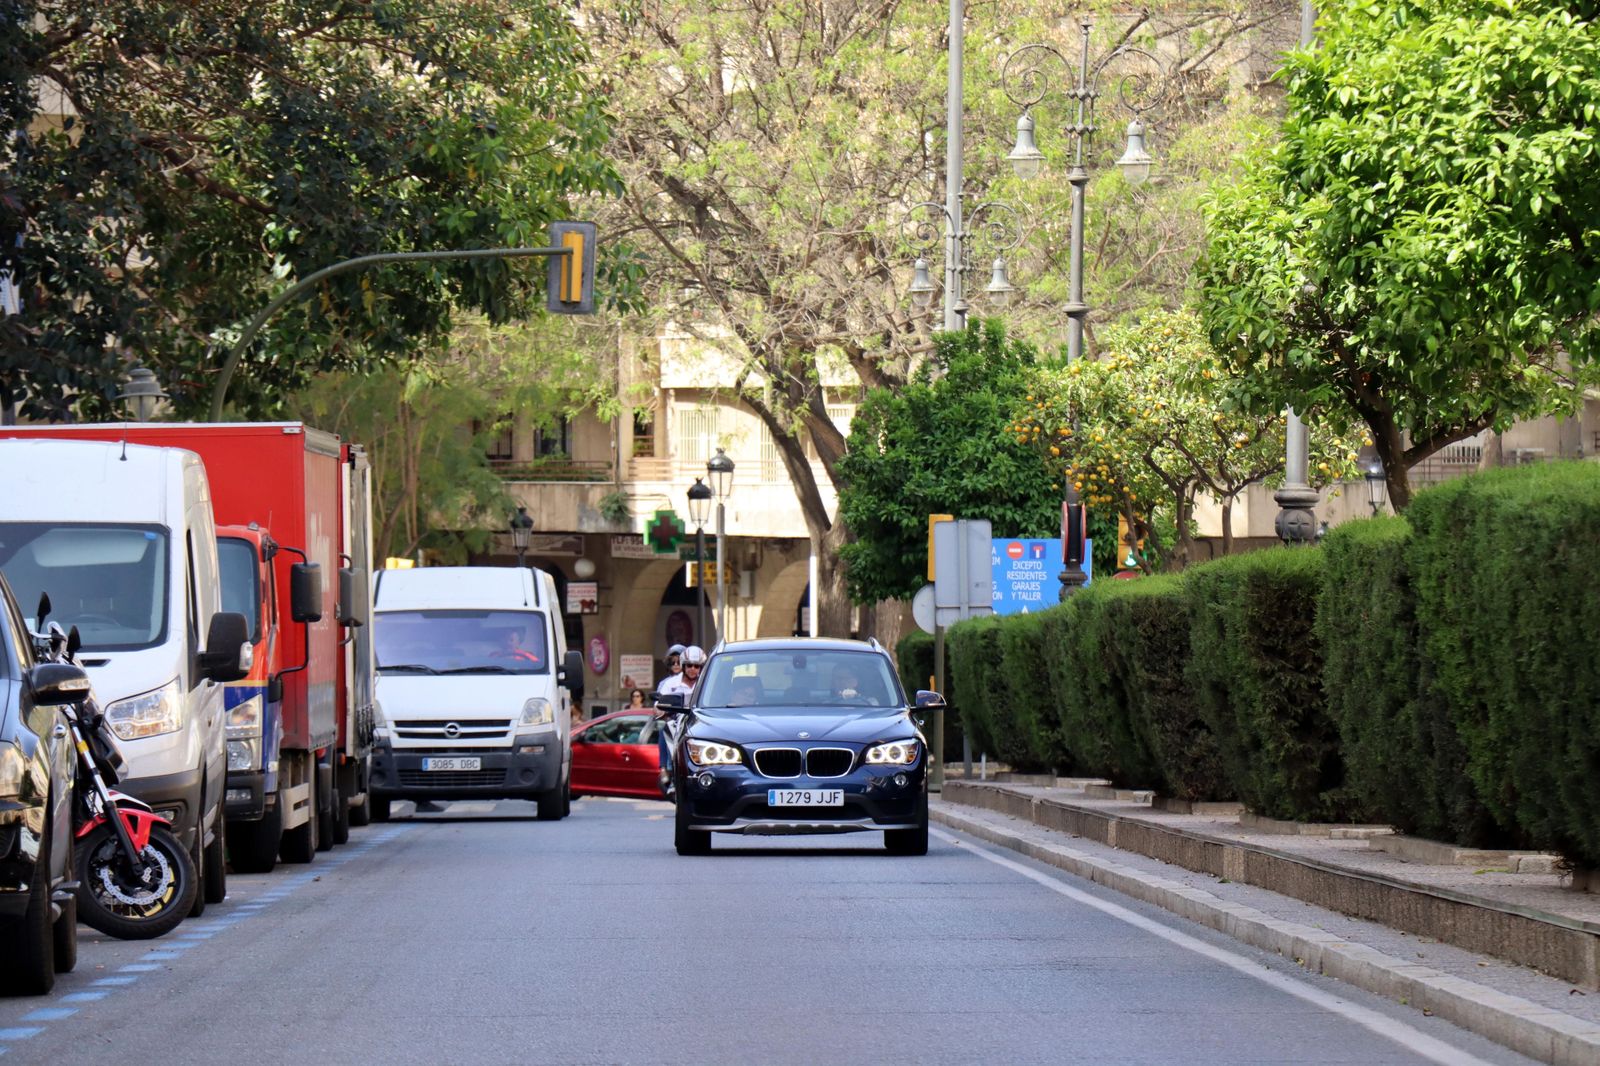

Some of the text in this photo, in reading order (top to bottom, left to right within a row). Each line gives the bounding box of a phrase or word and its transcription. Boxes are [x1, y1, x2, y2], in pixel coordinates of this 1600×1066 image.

[1012, 560, 1043, 570] EXCEPTO
[1006, 571, 1048, 580] RESIDENTES
[1011, 581, 1041, 591] GARAJES
[1011, 592, 1042, 600] Y TALLER
[431, 759, 478, 769] 3085 DBC
[779, 791, 841, 804] 1279 JJF
